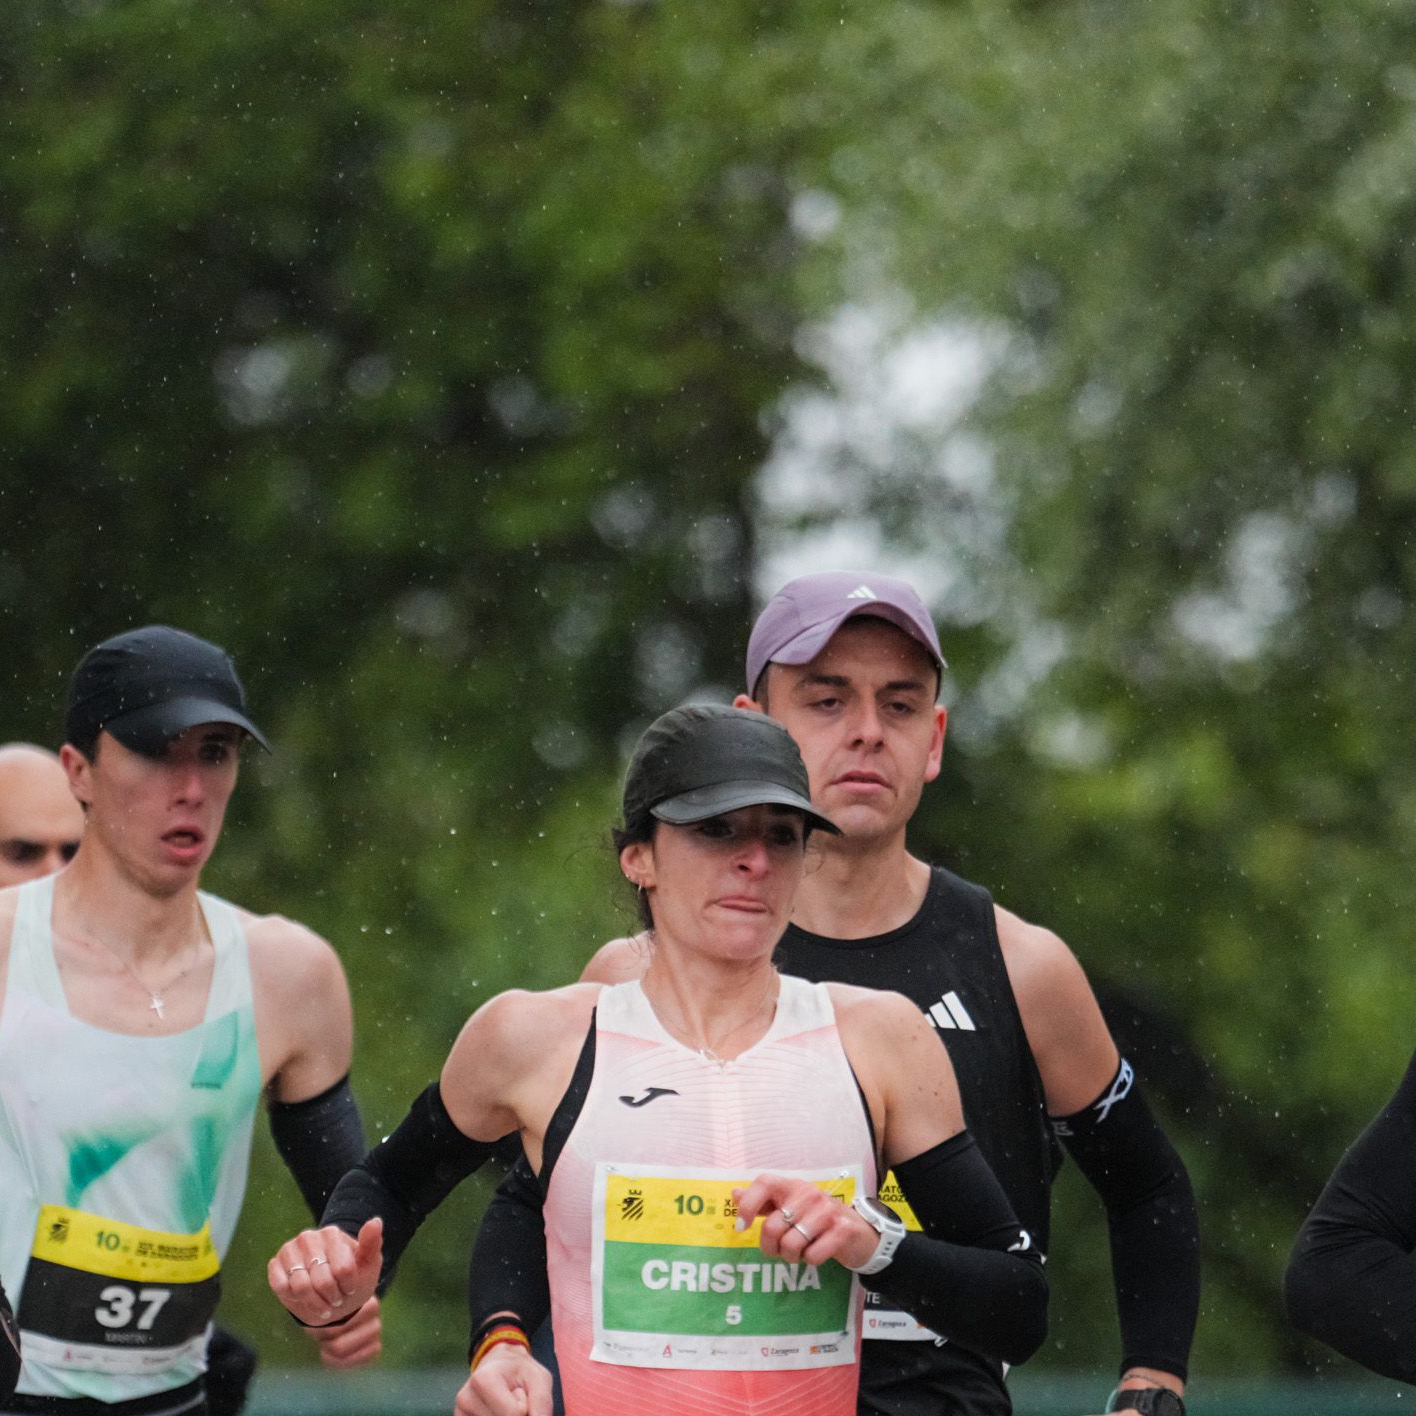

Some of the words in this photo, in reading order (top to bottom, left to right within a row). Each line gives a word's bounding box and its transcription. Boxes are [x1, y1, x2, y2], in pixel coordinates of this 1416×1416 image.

[674, 1194, 704, 1216] 10
[96, 1231, 121, 1251] 10
[641, 1259, 821, 1293] CRISTINA
[94, 1285, 172, 1330] 37
[725, 1305, 742, 1325] 5
